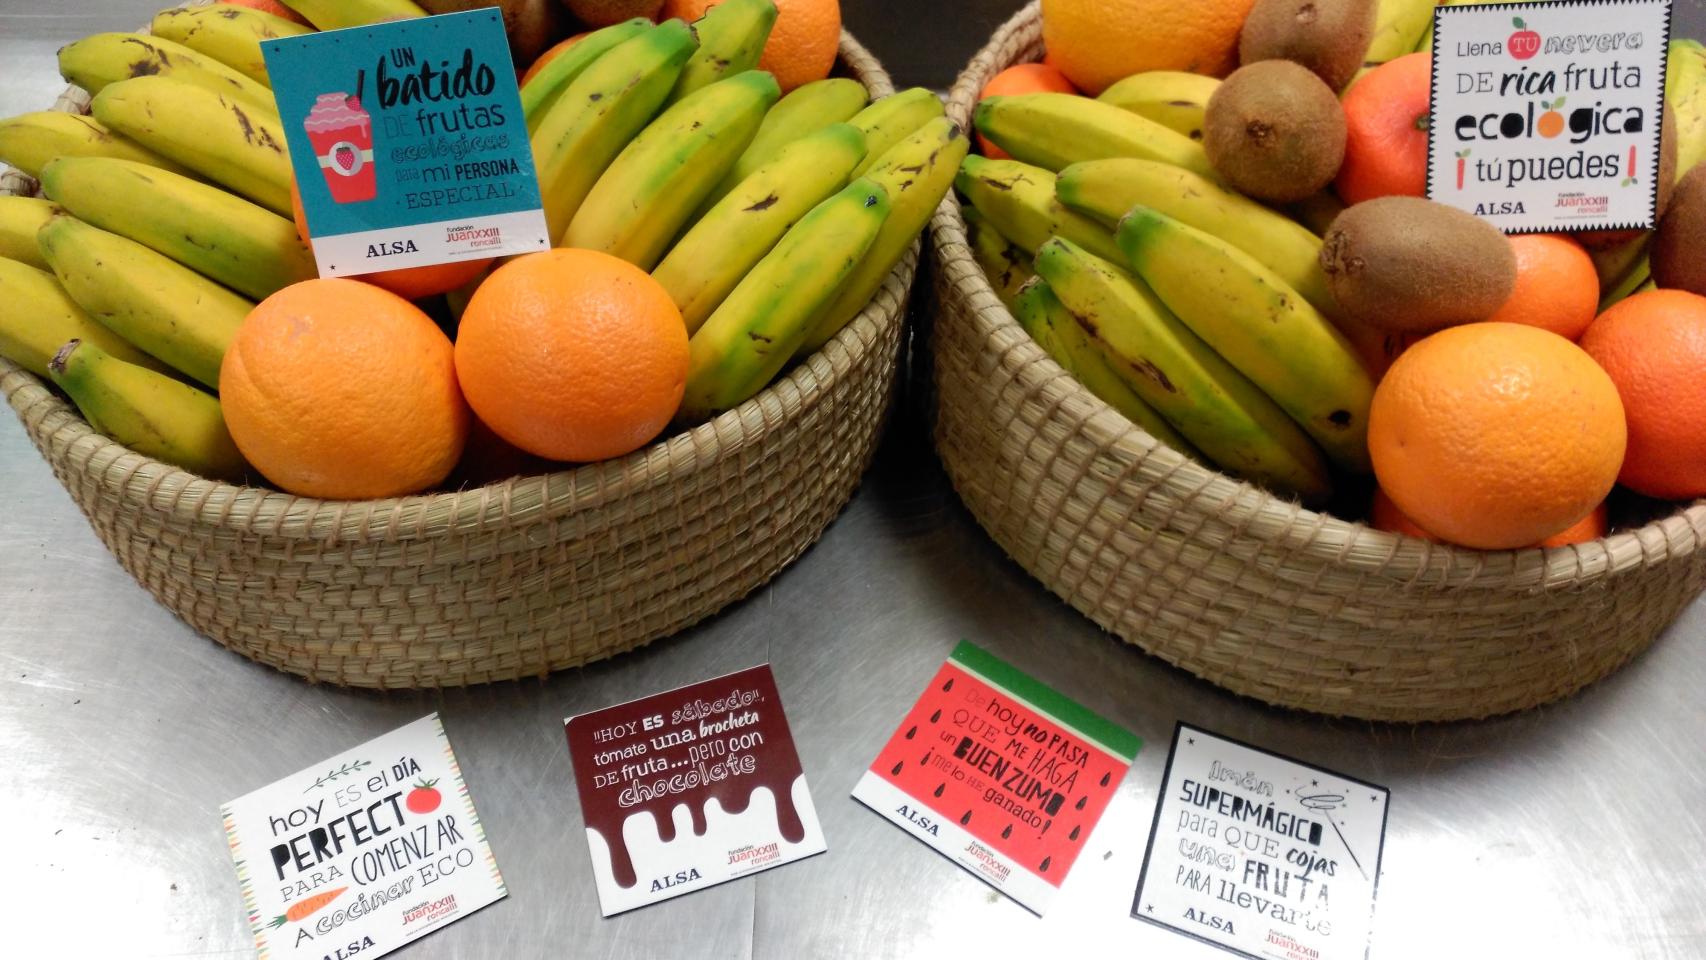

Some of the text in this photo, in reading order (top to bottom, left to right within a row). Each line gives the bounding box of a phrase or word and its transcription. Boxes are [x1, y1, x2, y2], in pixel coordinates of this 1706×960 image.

[390, 47, 416, 68] UN
[1457, 32, 1643, 57] Llena TU nevera
[376, 48, 495, 110] batido
[1456, 61, 1641, 96] DE rica fruta
[384, 103, 506, 139] DE frutas
[391, 132, 510, 164] ecológicas
[423, 165, 451, 183] mi
[456, 158, 520, 181] PERSONA
[406, 182, 515, 210] ESPECIAL
[1473, 202, 1526, 216] ALSA
[366, 239, 419, 258] ALSA
[594, 710, 760, 767] tómate una brocheta
[643, 715, 664, 732] ES
[940, 730, 957, 746] un
[986, 698, 1026, 736] hoy
[1023, 722, 1048, 744] no
[1048, 733, 1090, 768] PASA
[594, 771, 619, 789] DE
[689, 740, 726, 768] pero
[729, 732, 763, 751] con
[953, 708, 1079, 794] QUE ME HAGA
[618, 753, 756, 808] chocolate
[951, 766, 965, 782] lo
[967, 776, 985, 792] HE
[269, 757, 422, 836] hoy ES el DÍA
[1180, 779, 1323, 846] SUPERMÁGICO
[896, 804, 941, 838] ALSA
[281, 815, 464, 902] PARA COMENZAR
[1177, 810, 1338, 880] para QUE cojas
[650, 868, 702, 893] ALSA
[1176, 865, 1211, 895] PARA
[1178, 837, 1329, 912] una FRUTA
[295, 927, 314, 948] A
[315, 874, 415, 936] cocinar
[417, 847, 474, 887] ECO
[1183, 907, 1237, 935] ALSA
